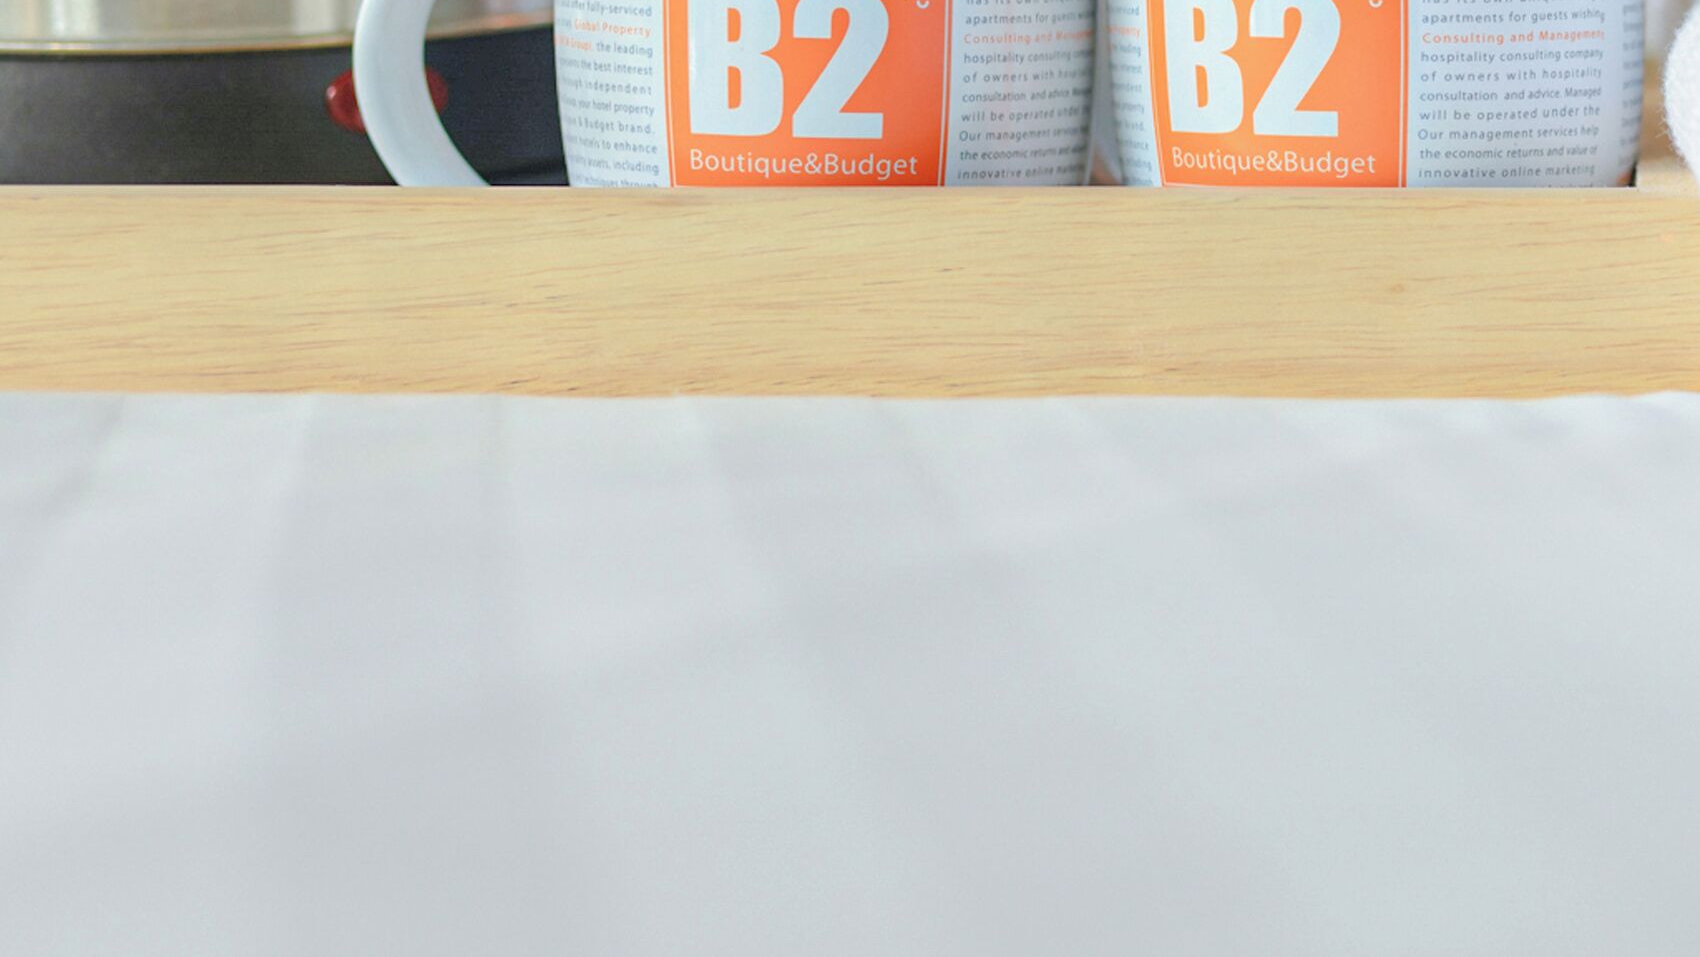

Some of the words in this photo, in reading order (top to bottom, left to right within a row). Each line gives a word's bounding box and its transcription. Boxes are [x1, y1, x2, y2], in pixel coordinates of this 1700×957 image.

[966, 15, 1032, 27] apartments
[1422, 13, 1504, 25] apartments
[1508, 11, 1527, 22] for
[1531, 11, 1568, 24] guests
[602, 22, 651, 37] Property
[964, 33, 1031, 45] Consulting
[1422, 32, 1505, 45] Consulting
[1510, 31, 1534, 42] and
[614, 42, 653, 58] leading
[1420, 50, 1495, 64] hospitality
[1500, 49, 1561, 62] consulting
[1564, 49, 1604, 60] company
[964, 52, 1024, 65] hospitality
[614, 63, 652, 75] interest
[1420, 71, 1437, 82] of
[1444, 72, 1500, 82] owners
[1506, 69, 1536, 81] with
[1542, 66, 1602, 81] hospitality
[963, 72, 977, 83] of
[984, 73, 1028, 82] owners
[962, 92, 1026, 103] consultation
[1420, 91, 1498, 101] consultation
[1504, 90, 1525, 100] and
[1565, 87, 1602, 99] Managed
[614, 103, 654, 116] property
[1420, 110, 1447, 120] will
[1453, 109, 1471, 120] be
[1477, 108, 1537, 121] operated
[1543, 106, 1579, 118] under
[1583, 104, 1600, 116] the
[961, 111, 985, 122] will
[990, 111, 1004, 121] be
[959, 130, 981, 142] Our
[985, 129, 1050, 142] management
[1418, 129, 1443, 140] Our
[1449, 129, 1533, 142] management
[1537, 126, 1578, 138] services
[614, 141, 657, 153] enhance
[1420, 149, 1441, 159] the
[1444, 148, 1503, 158] economic
[1506, 148, 1544, 158] returns
[1547, 146, 1564, 156] and
[960, 150, 978, 160] the
[614, 160, 658, 175] including
[690, 149, 918, 180] Boutique&Budget
[1171, 146, 1376, 178] Boutique&Budget
[1419, 168, 1497, 178] innovative
[1501, 166, 1541, 178] online
[1545, 165, 1595, 176] marketing
